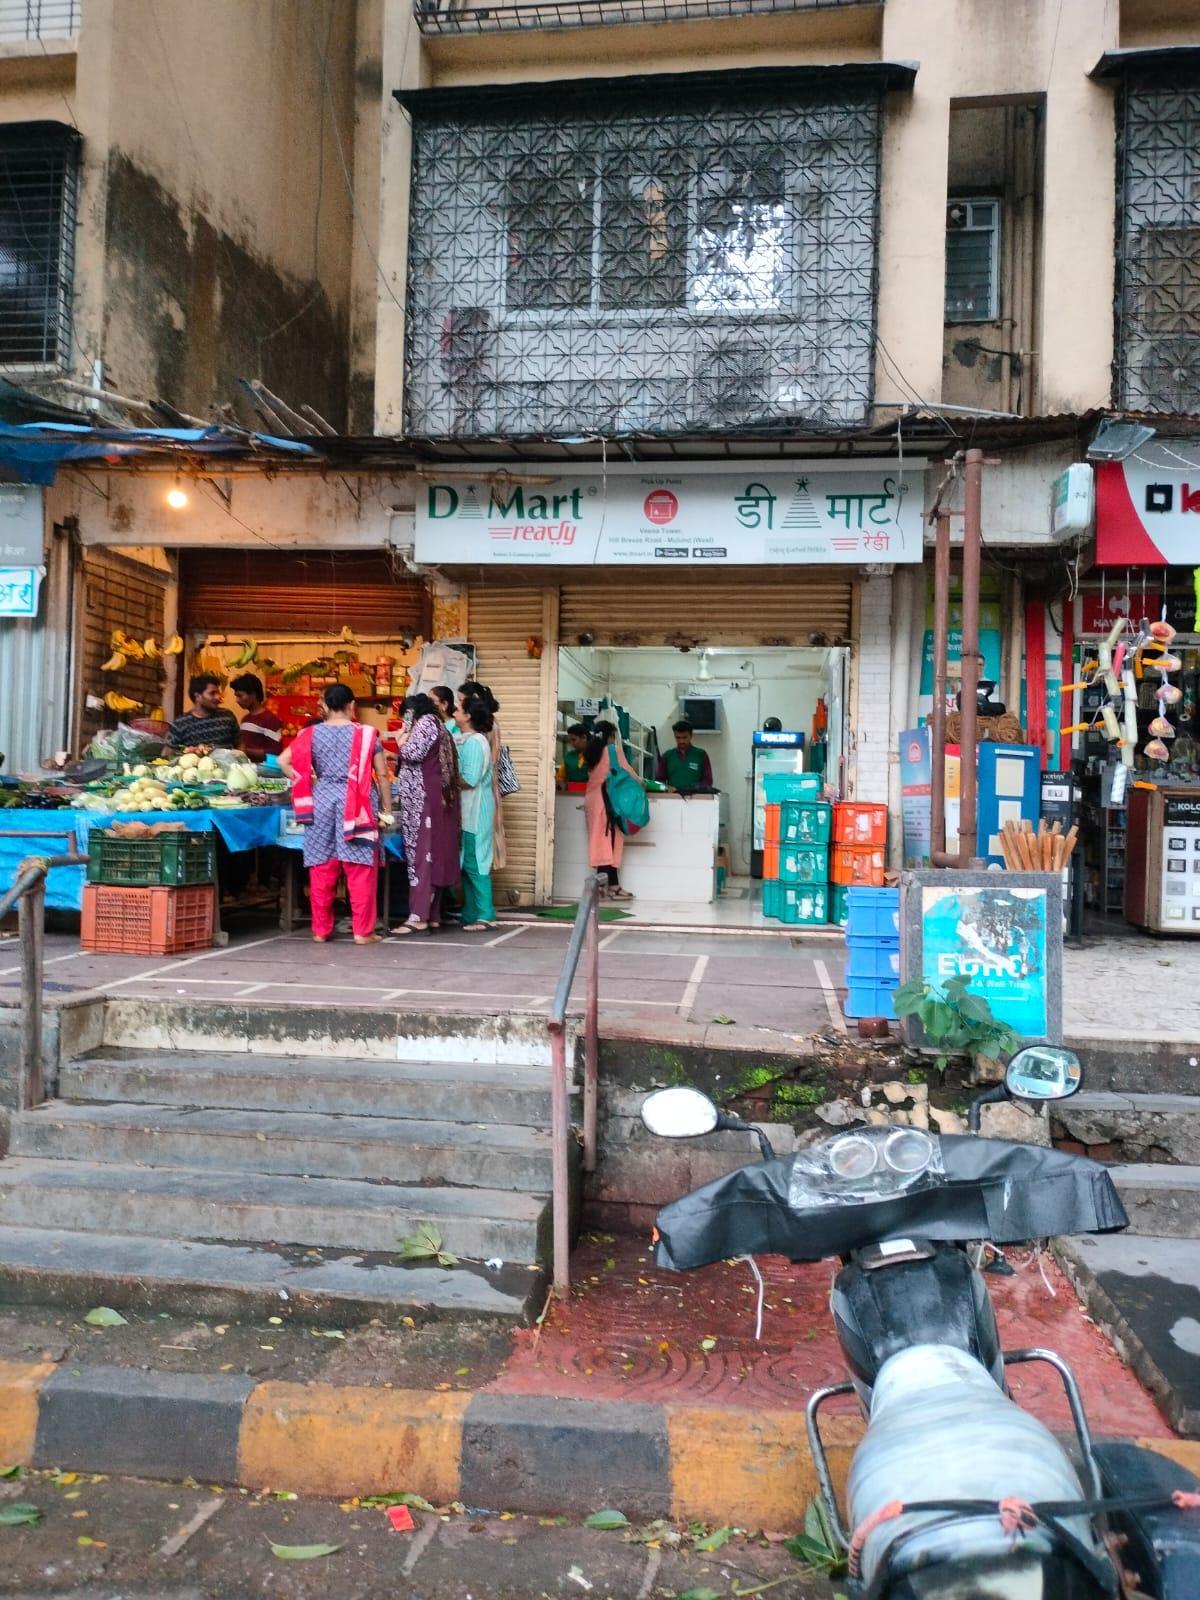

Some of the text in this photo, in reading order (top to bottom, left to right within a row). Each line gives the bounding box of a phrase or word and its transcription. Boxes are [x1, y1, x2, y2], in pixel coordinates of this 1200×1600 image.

[487, 485, 584, 520] Mart
[734, 477, 895, 529] डी मार्ट
[512, 520, 577, 545] ready
[862, 530, 891, 551] रेडी
